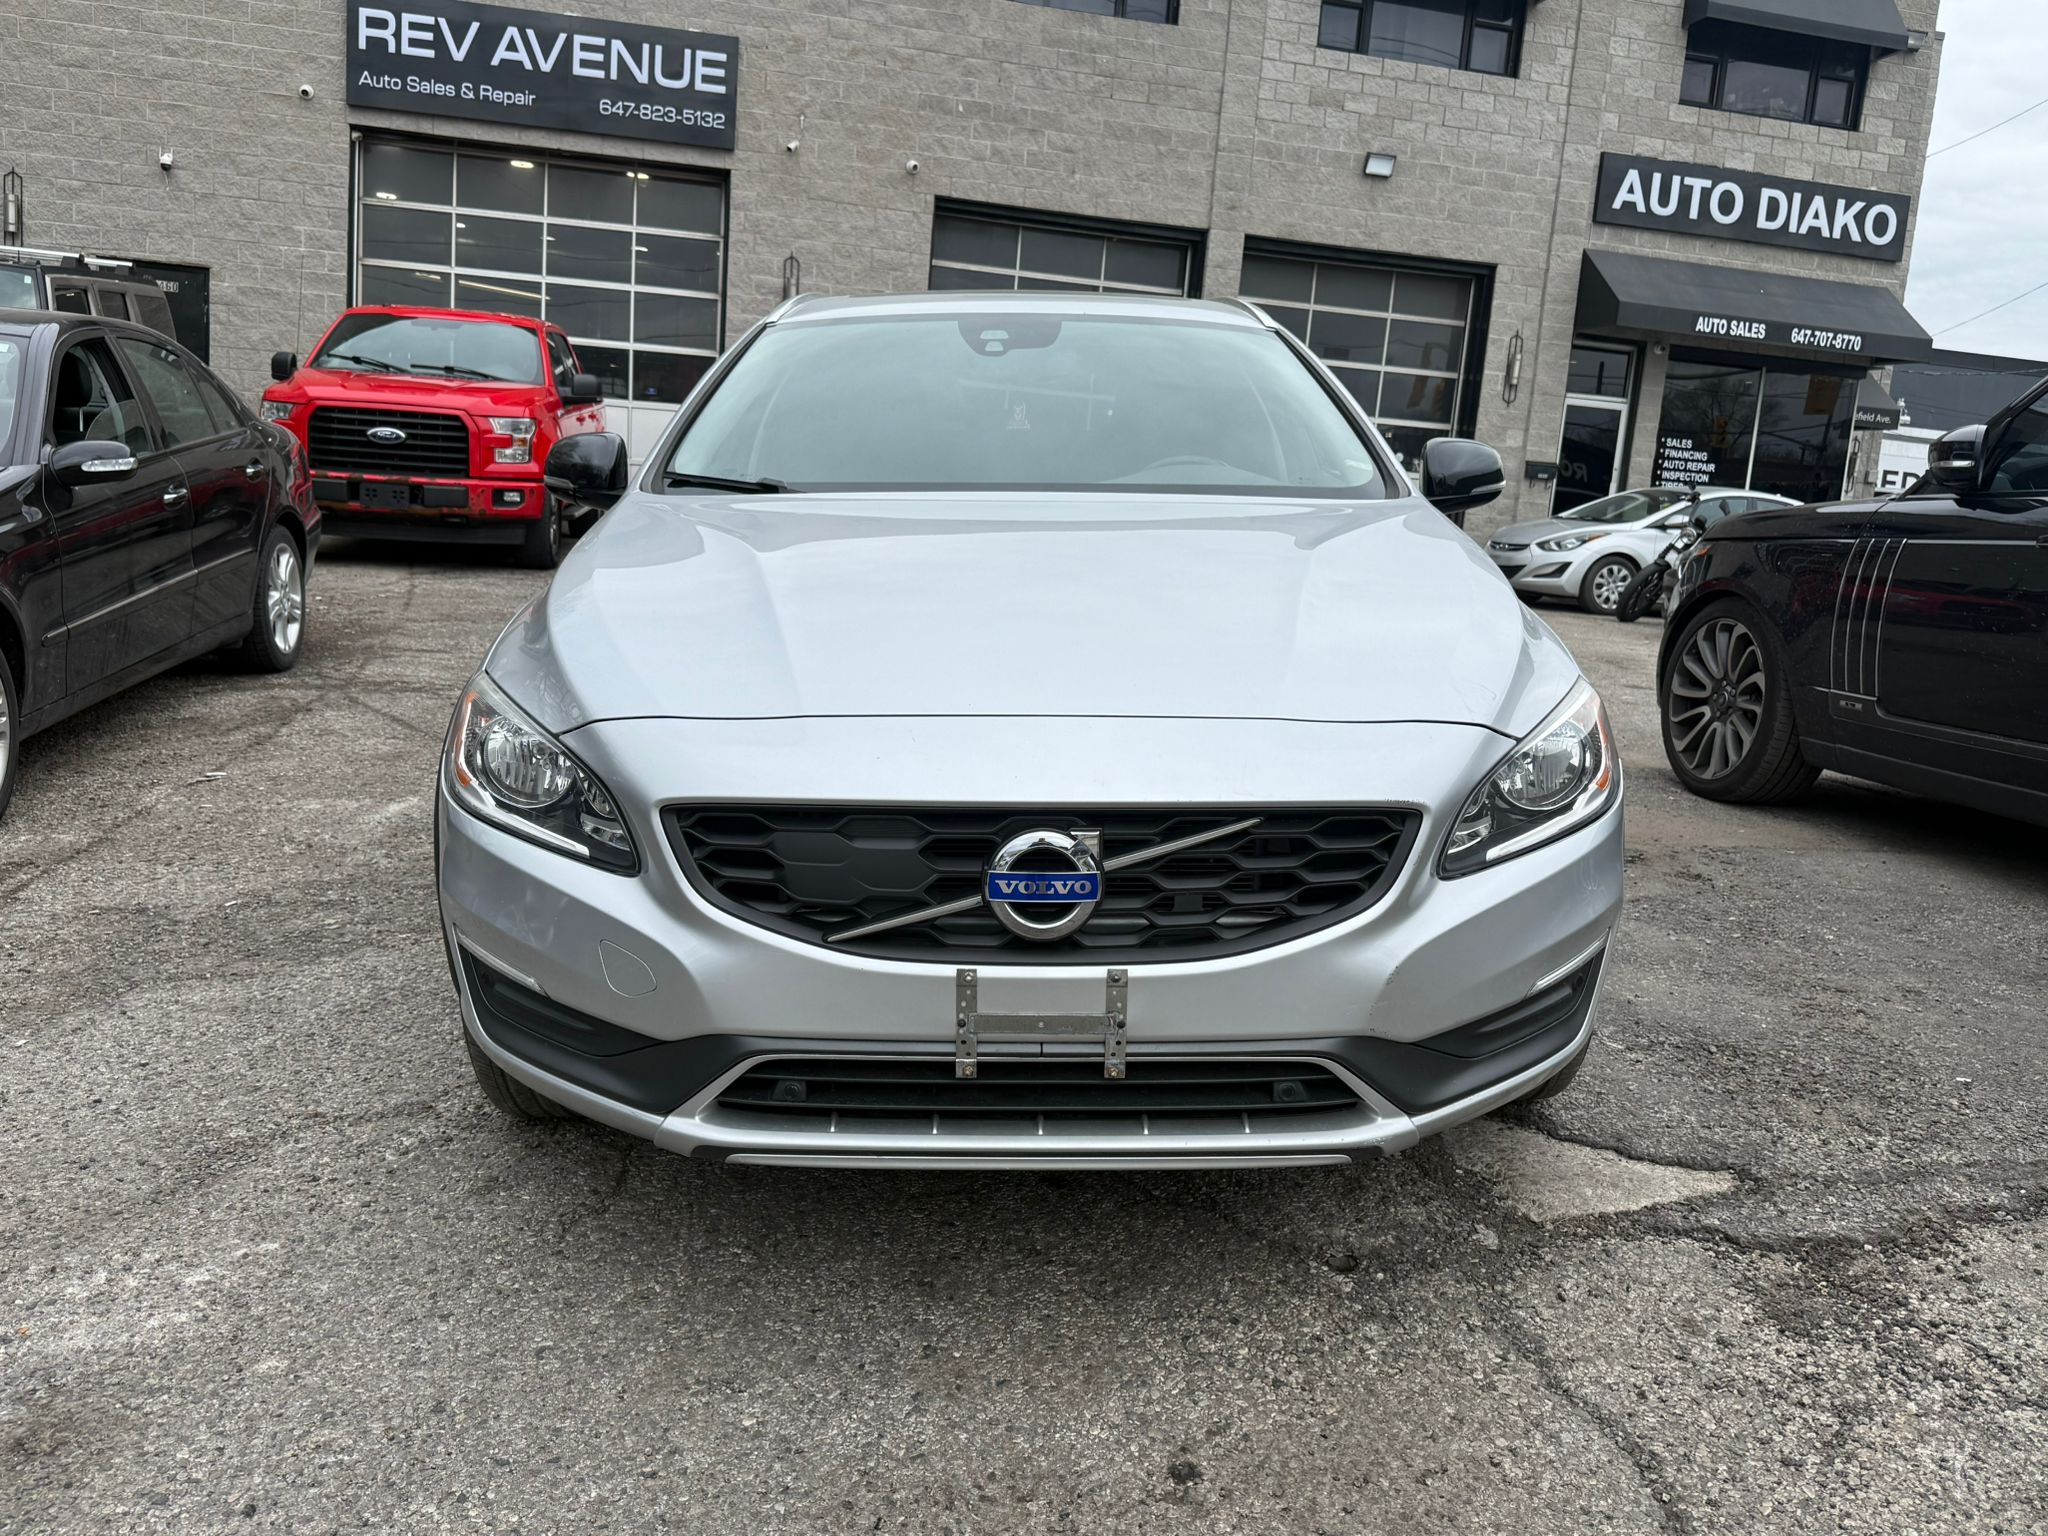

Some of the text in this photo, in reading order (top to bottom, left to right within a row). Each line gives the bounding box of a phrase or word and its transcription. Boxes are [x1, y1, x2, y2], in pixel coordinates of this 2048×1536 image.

[358, 7, 727, 94] REV AVENUE
[358, 70, 536, 106] Auto Sales & Repair
[599, 99, 726, 129] 647-823-5132
[1611, 168, 1897, 246] AUTO DIAKO
[1696, 316, 1766, 339] AUTO SALES
[1791, 328, 1862, 351] 647-707-8770
[1664, 449, 1708, 461] FINANCING
[1666, 438, 1693, 449] SALES
[1661, 470, 1710, 483] INSPECTION
[1662, 459, 1716, 473] AUTO REPAIR
[994, 880, 1093, 895] VOLVO
